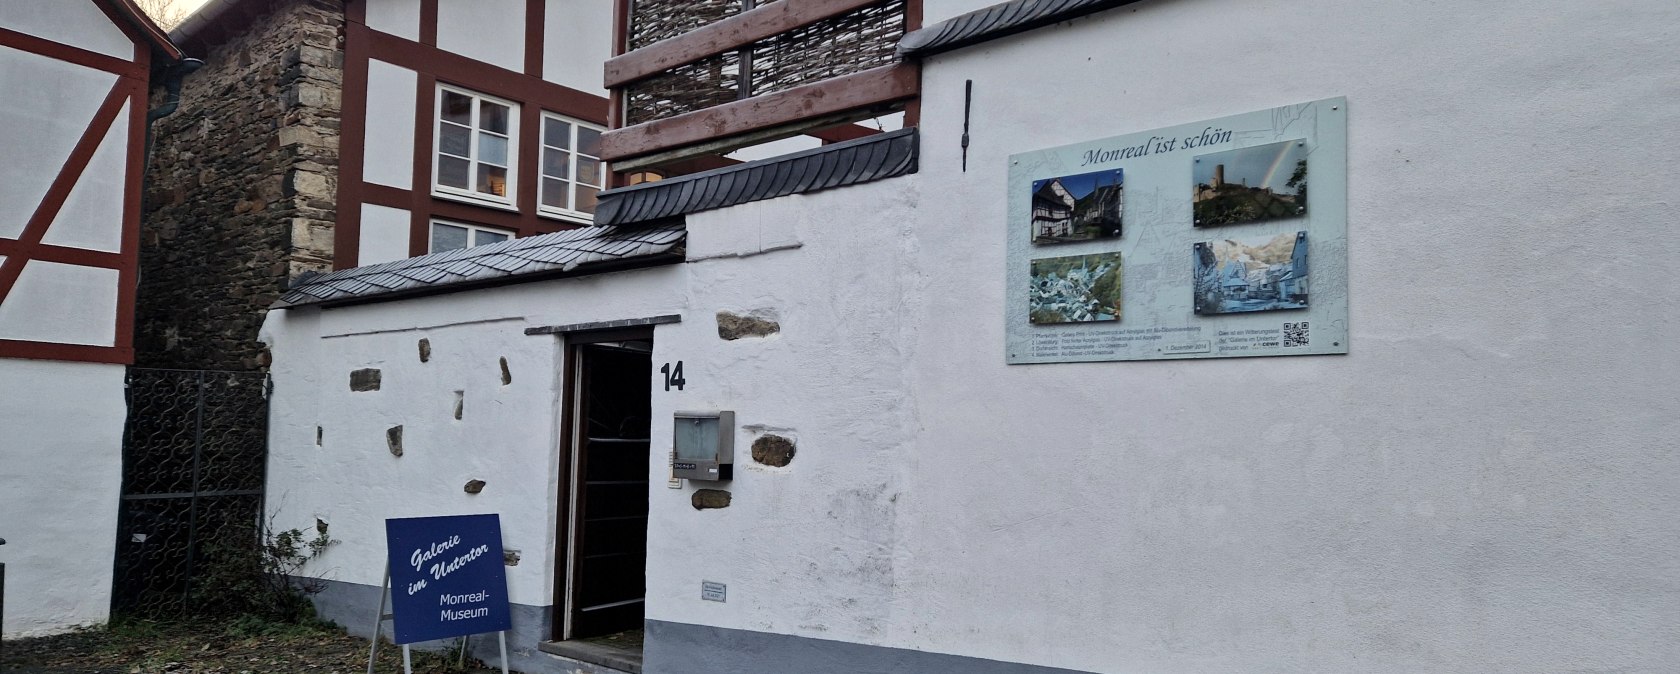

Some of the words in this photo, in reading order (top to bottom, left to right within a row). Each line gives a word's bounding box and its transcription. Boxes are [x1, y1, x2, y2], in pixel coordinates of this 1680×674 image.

[1081, 136, 1156, 167] Monreal
[1181, 126, 1233, 150] schön
[660, 360, 686, 391] 14
[408, 579, 427, 595] im
[430, 544, 489, 580] Untertor
[410, 534, 461, 572] Galerie
[440, 589, 490, 606] Monreal-
[440, 607, 489, 621] Museum
